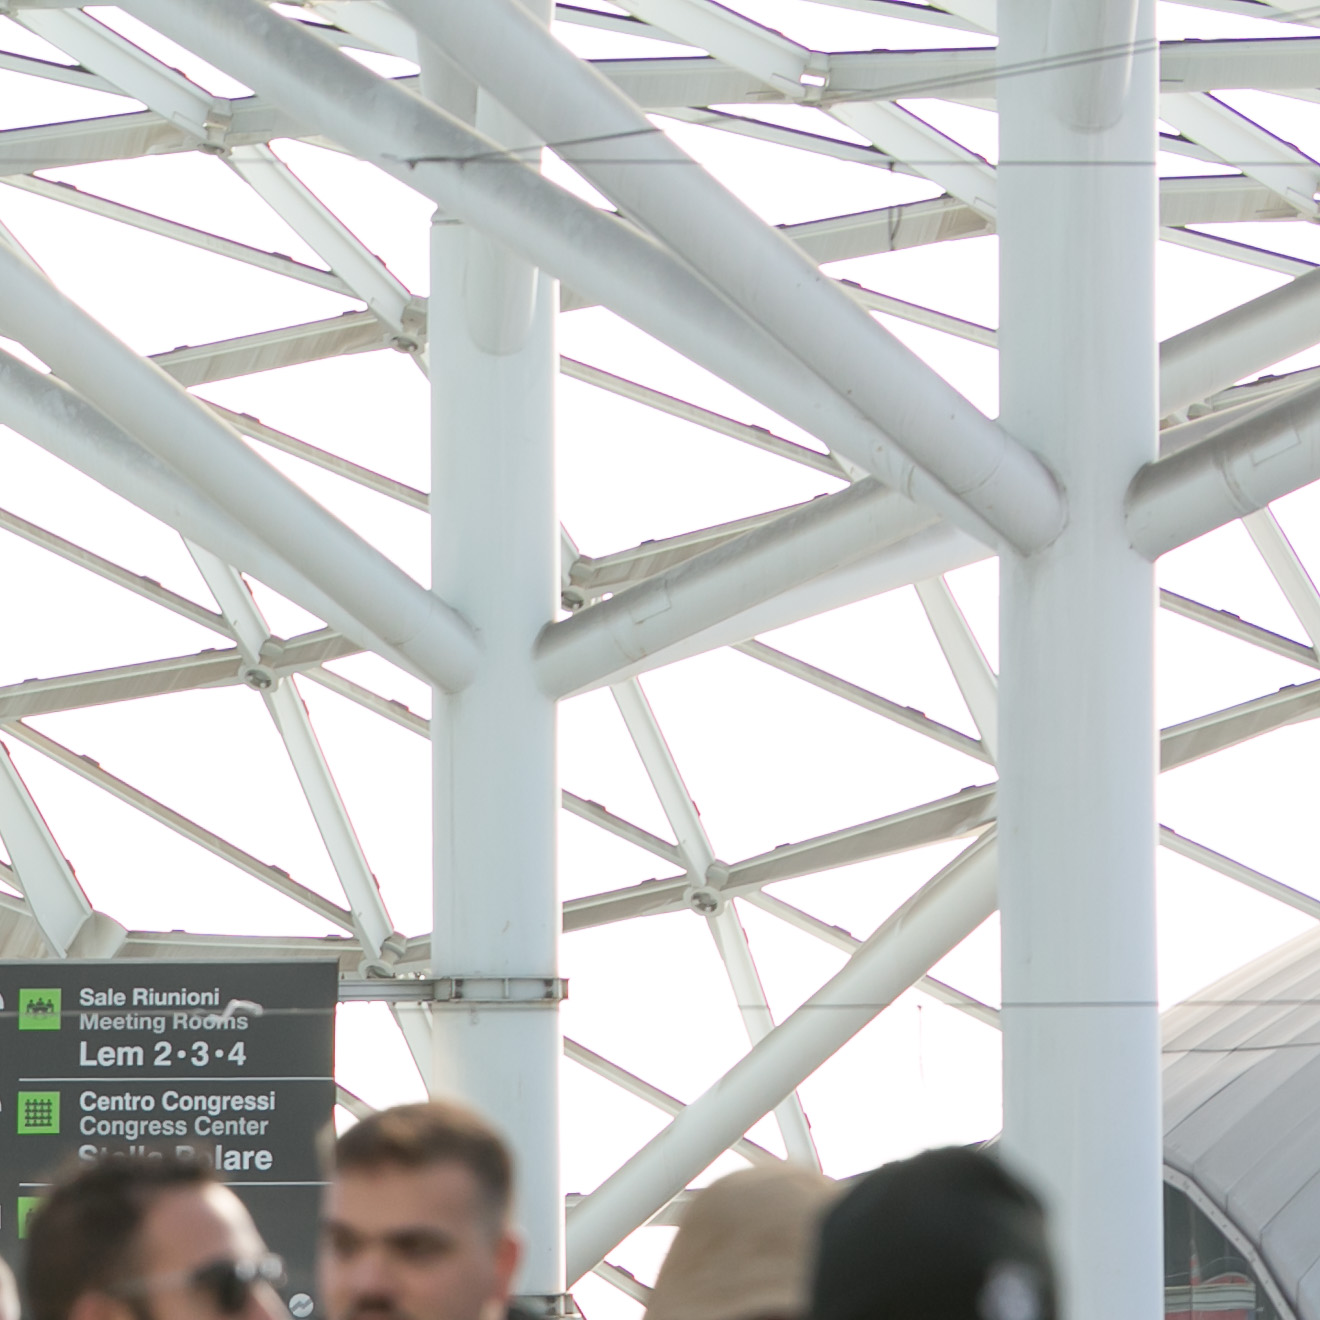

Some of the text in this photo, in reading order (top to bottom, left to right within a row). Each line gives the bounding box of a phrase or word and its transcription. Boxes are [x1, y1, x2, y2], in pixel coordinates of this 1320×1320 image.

[79, 987, 220, 1007] Sale Riunioni
[79, 1012, 249, 1034] Meeting Rooms
[79, 1041, 144, 1067] Lem
[79, 1091, 276, 1116] Centro Congressi
[79, 1115, 269, 1140] Congress Center
[175, 1144, 273, 1171] Plare
